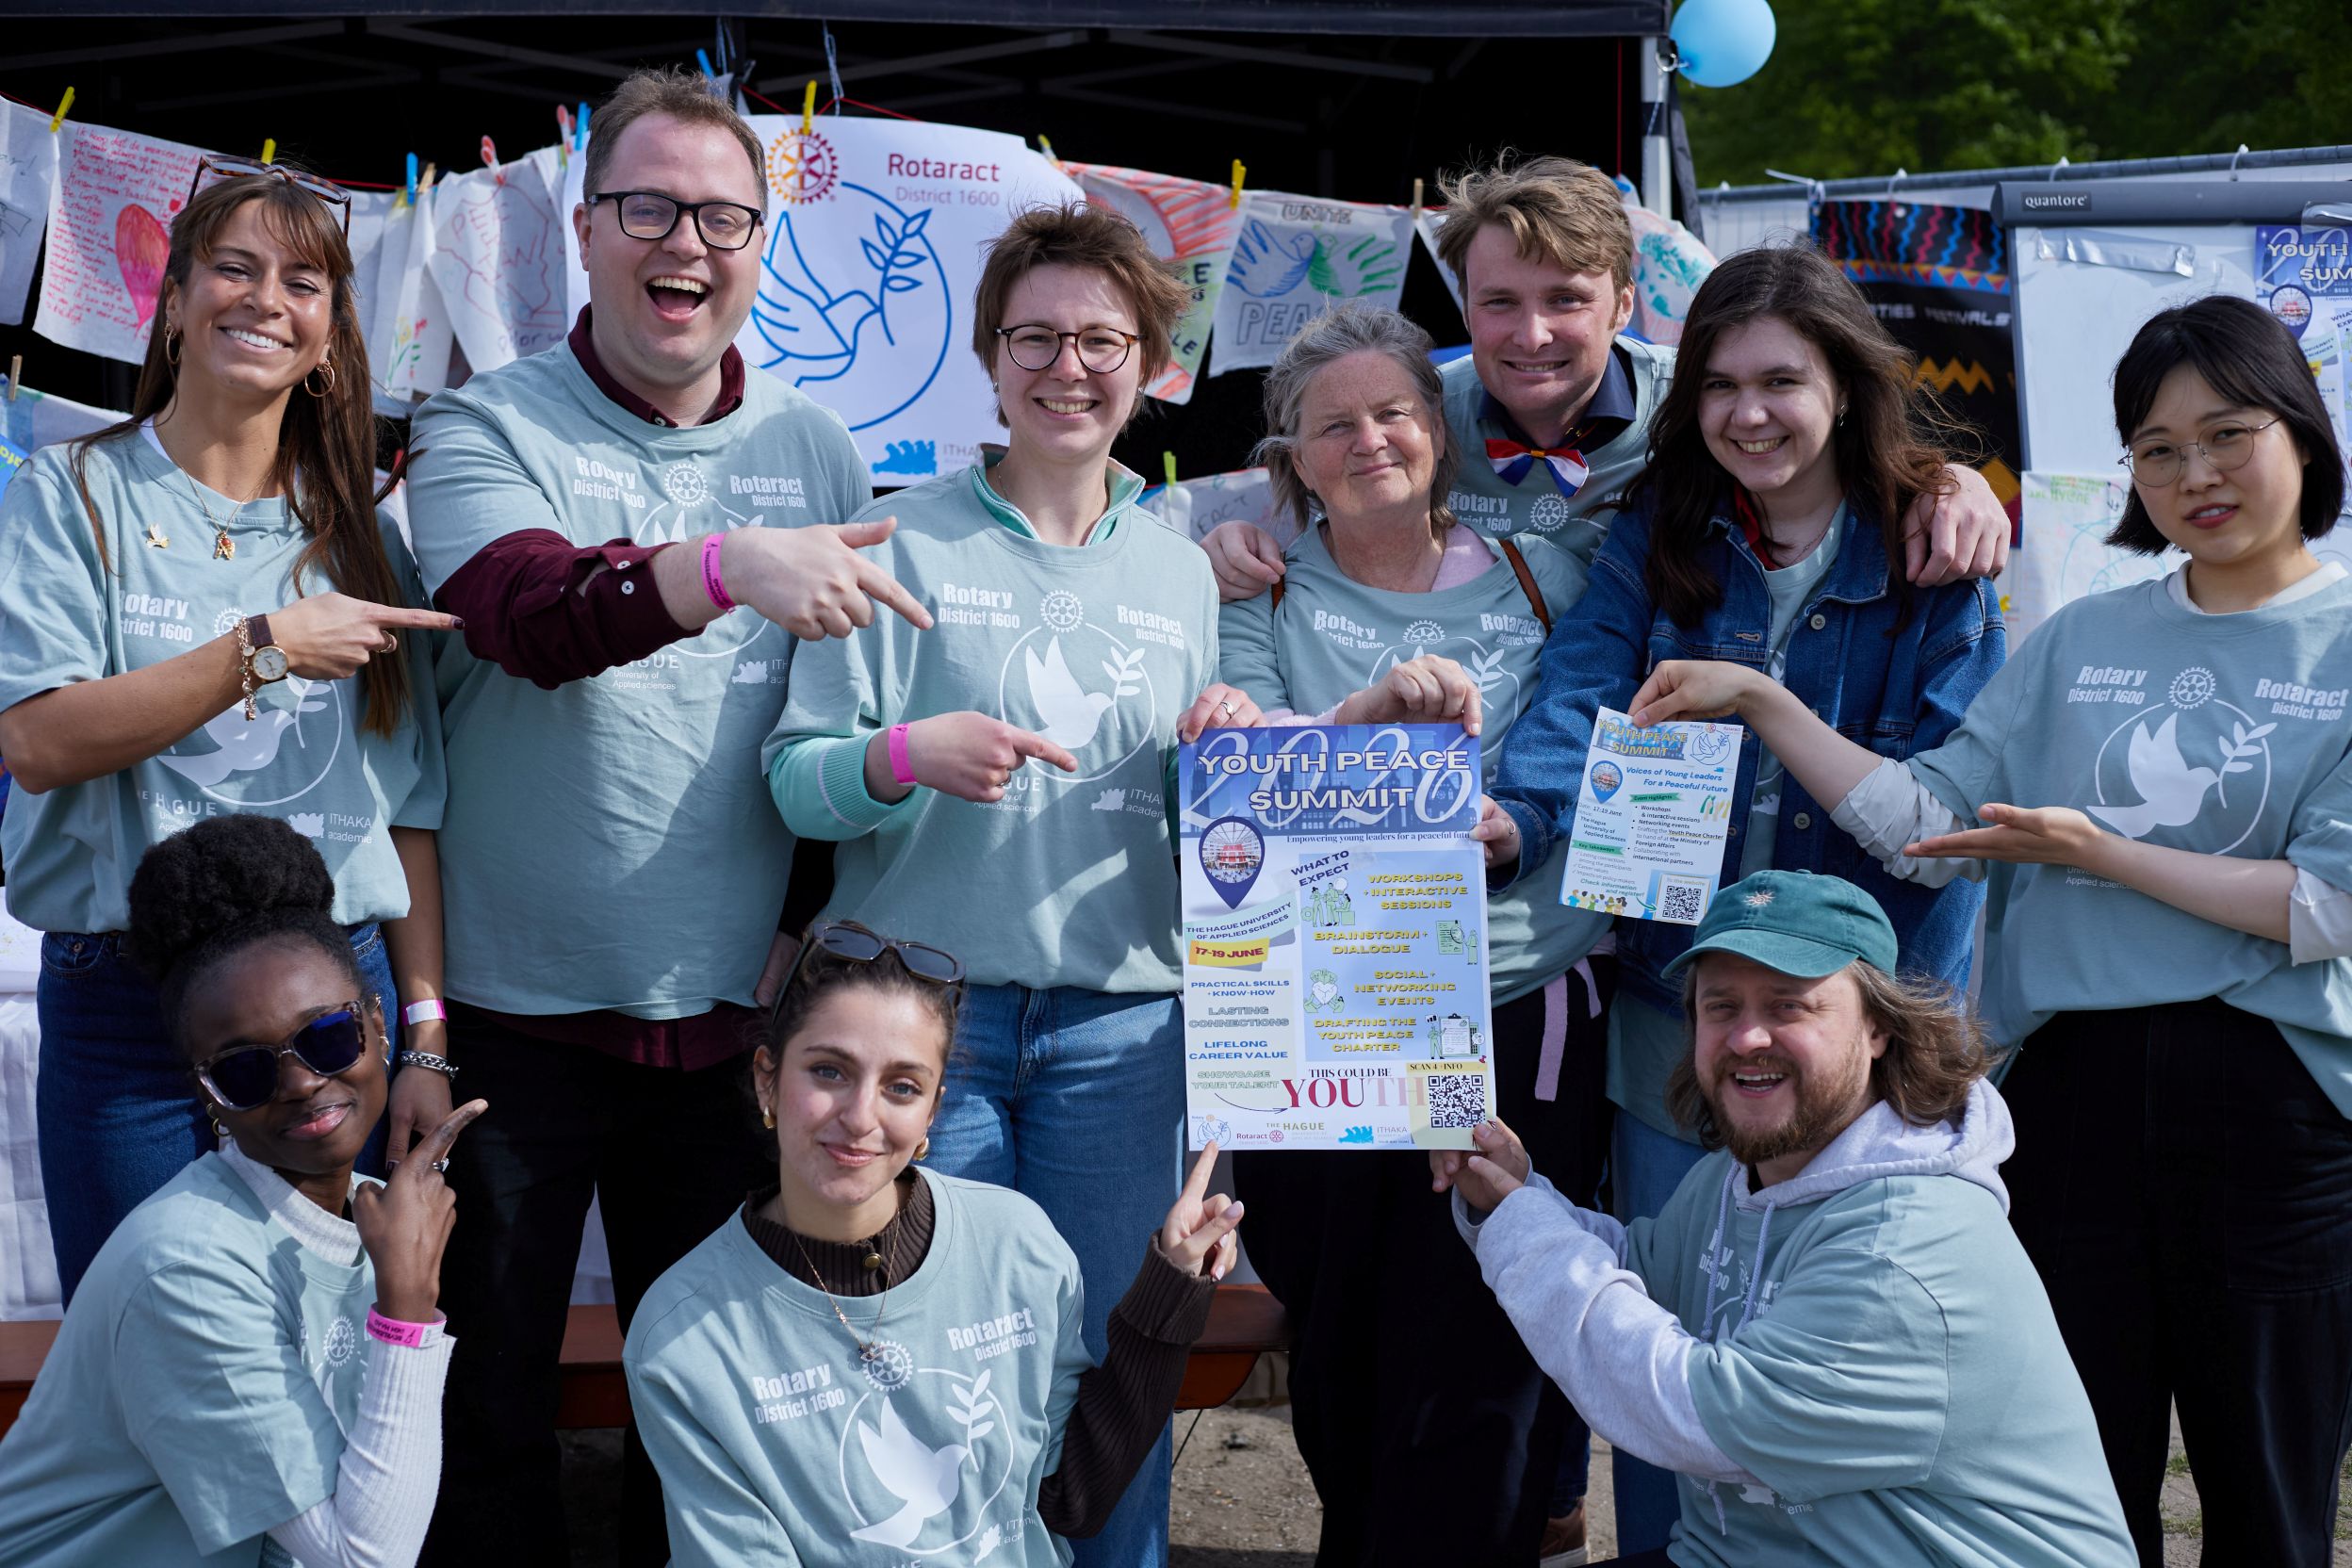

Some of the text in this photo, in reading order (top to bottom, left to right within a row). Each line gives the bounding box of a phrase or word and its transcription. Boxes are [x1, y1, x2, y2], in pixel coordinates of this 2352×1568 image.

[889, 153, 1000, 183] Rotaract
[896, 187, 999, 206] District 1600
[2025, 194, 2084, 208] quantore
[2267, 243, 2348, 257] YOUTH
[1236, 302, 1315, 346] PEA
[574, 479, 620, 501] District
[729, 474, 804, 495] Rotaract
[752, 494, 807, 508] District 1600
[1446, 491, 1508, 514] Rotary
[1487, 517, 1511, 531] 1600
[943, 583, 1012, 610] Rotary
[939, 607, 1020, 629] District 1600
[1118, 605, 1184, 638] Rotaract
[1479, 612, 1542, 637] Rotaract
[159, 621, 192, 642] 1600
[1314, 610, 1376, 641] Rotary
[1135, 628, 1184, 650] District 1600
[1357, 639, 1385, 649] 1600
[1495, 633, 1524, 645] District
[613, 680, 641, 689] Applied
[2076, 665, 2350, 707] Rotary Rotaract
[2067, 688, 2146, 705] District 1600
[2271, 701, 2344, 721] District 1600
[1598, 719, 1688, 743] YOUTH PEACE
[1612, 742, 1668, 756] SUMMIT
[1199, 750, 1470, 775] YOUTH PEACE
[1664, 770, 1689, 779] Young
[1690, 772, 1723, 781] Leaders
[1665, 780, 1700, 791] Peaceful
[1249, 788, 1413, 810] SUMMIT
[330, 813, 372, 829] ITHAKA
[1583, 824, 1609, 833] University
[328, 831, 372, 843] academie
[1287, 835, 1338, 843] Empowering
[1291, 851, 1349, 875] WHAT TO
[1633, 855, 1669, 863] international
[1298, 863, 1349, 886] EXPECT
[1368, 874, 1463, 883] WORKSHOPS
[2065, 875, 2097, 887] Applied
[1371, 888, 1468, 897] INTERACTIVE
[1602, 881, 1637, 890] information
[1381, 900, 1452, 909] SESSIONS
[1206, 923, 1238, 932] HAGUE
[1240, 902, 1292, 928] UNIVERSITY
[1210, 930, 1248, 939] APPLIED
[1250, 914, 1289, 934] SCIENCES
[1314, 931, 1420, 941] BRAINSTORM
[1195, 946, 1265, 958] 17-19 JUNE
[1331, 945, 1411, 955] DIALOGUE
[1374, 971, 1428, 980] SOCIAL
[1354, 983, 1456, 993] NETWORKING
[1377, 997, 1435, 1005] EVENTS
[1208, 1006, 1269, 1016] LASTING
[1188, 1018, 1289, 1028] CONNECTIONS
[1315, 1018, 1416, 1028] DRAFTING THE
[1318, 1031, 1414, 1039] YOUTH PEACE
[1332, 1044, 1400, 1053] CHARTER
[1309, 1068, 1392, 1078] THIS COULD BE
[1282, 1077, 1427, 1108] YOUTH
[947, 1307, 1036, 1351] Rotaract
[974, 1331, 1037, 1362] District 1600
[752, 1364, 831, 1400] Rotary
[755, 1388, 845, 1425] District 1600
